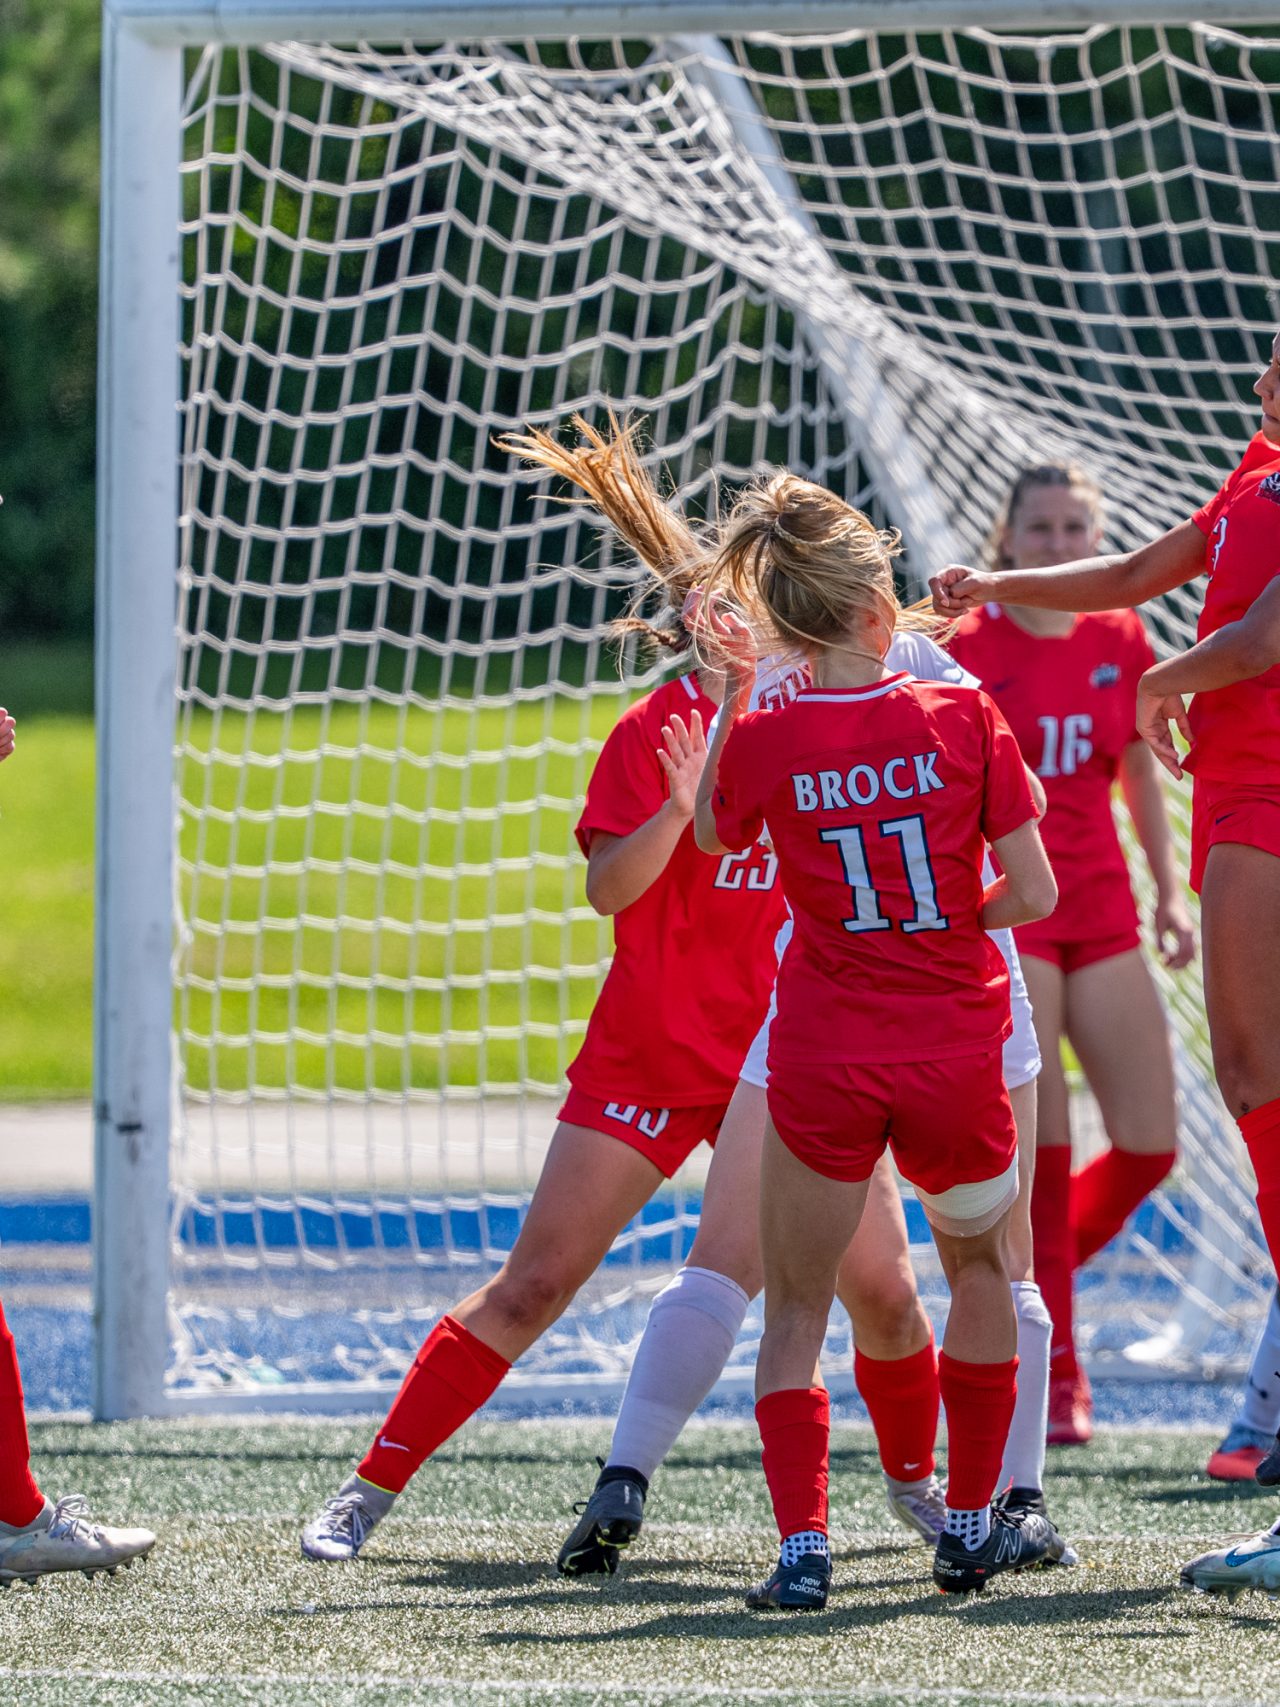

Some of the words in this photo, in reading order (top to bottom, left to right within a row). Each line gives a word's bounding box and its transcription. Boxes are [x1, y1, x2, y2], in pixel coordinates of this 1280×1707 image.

[1035, 713, 1093, 777] 16
[791, 751, 945, 813] BROCK
[712, 843, 779, 892] 23
[818, 813, 950, 934] 11
[788, 1581, 826, 1598] balance
[800, 1575, 821, 1588] new
